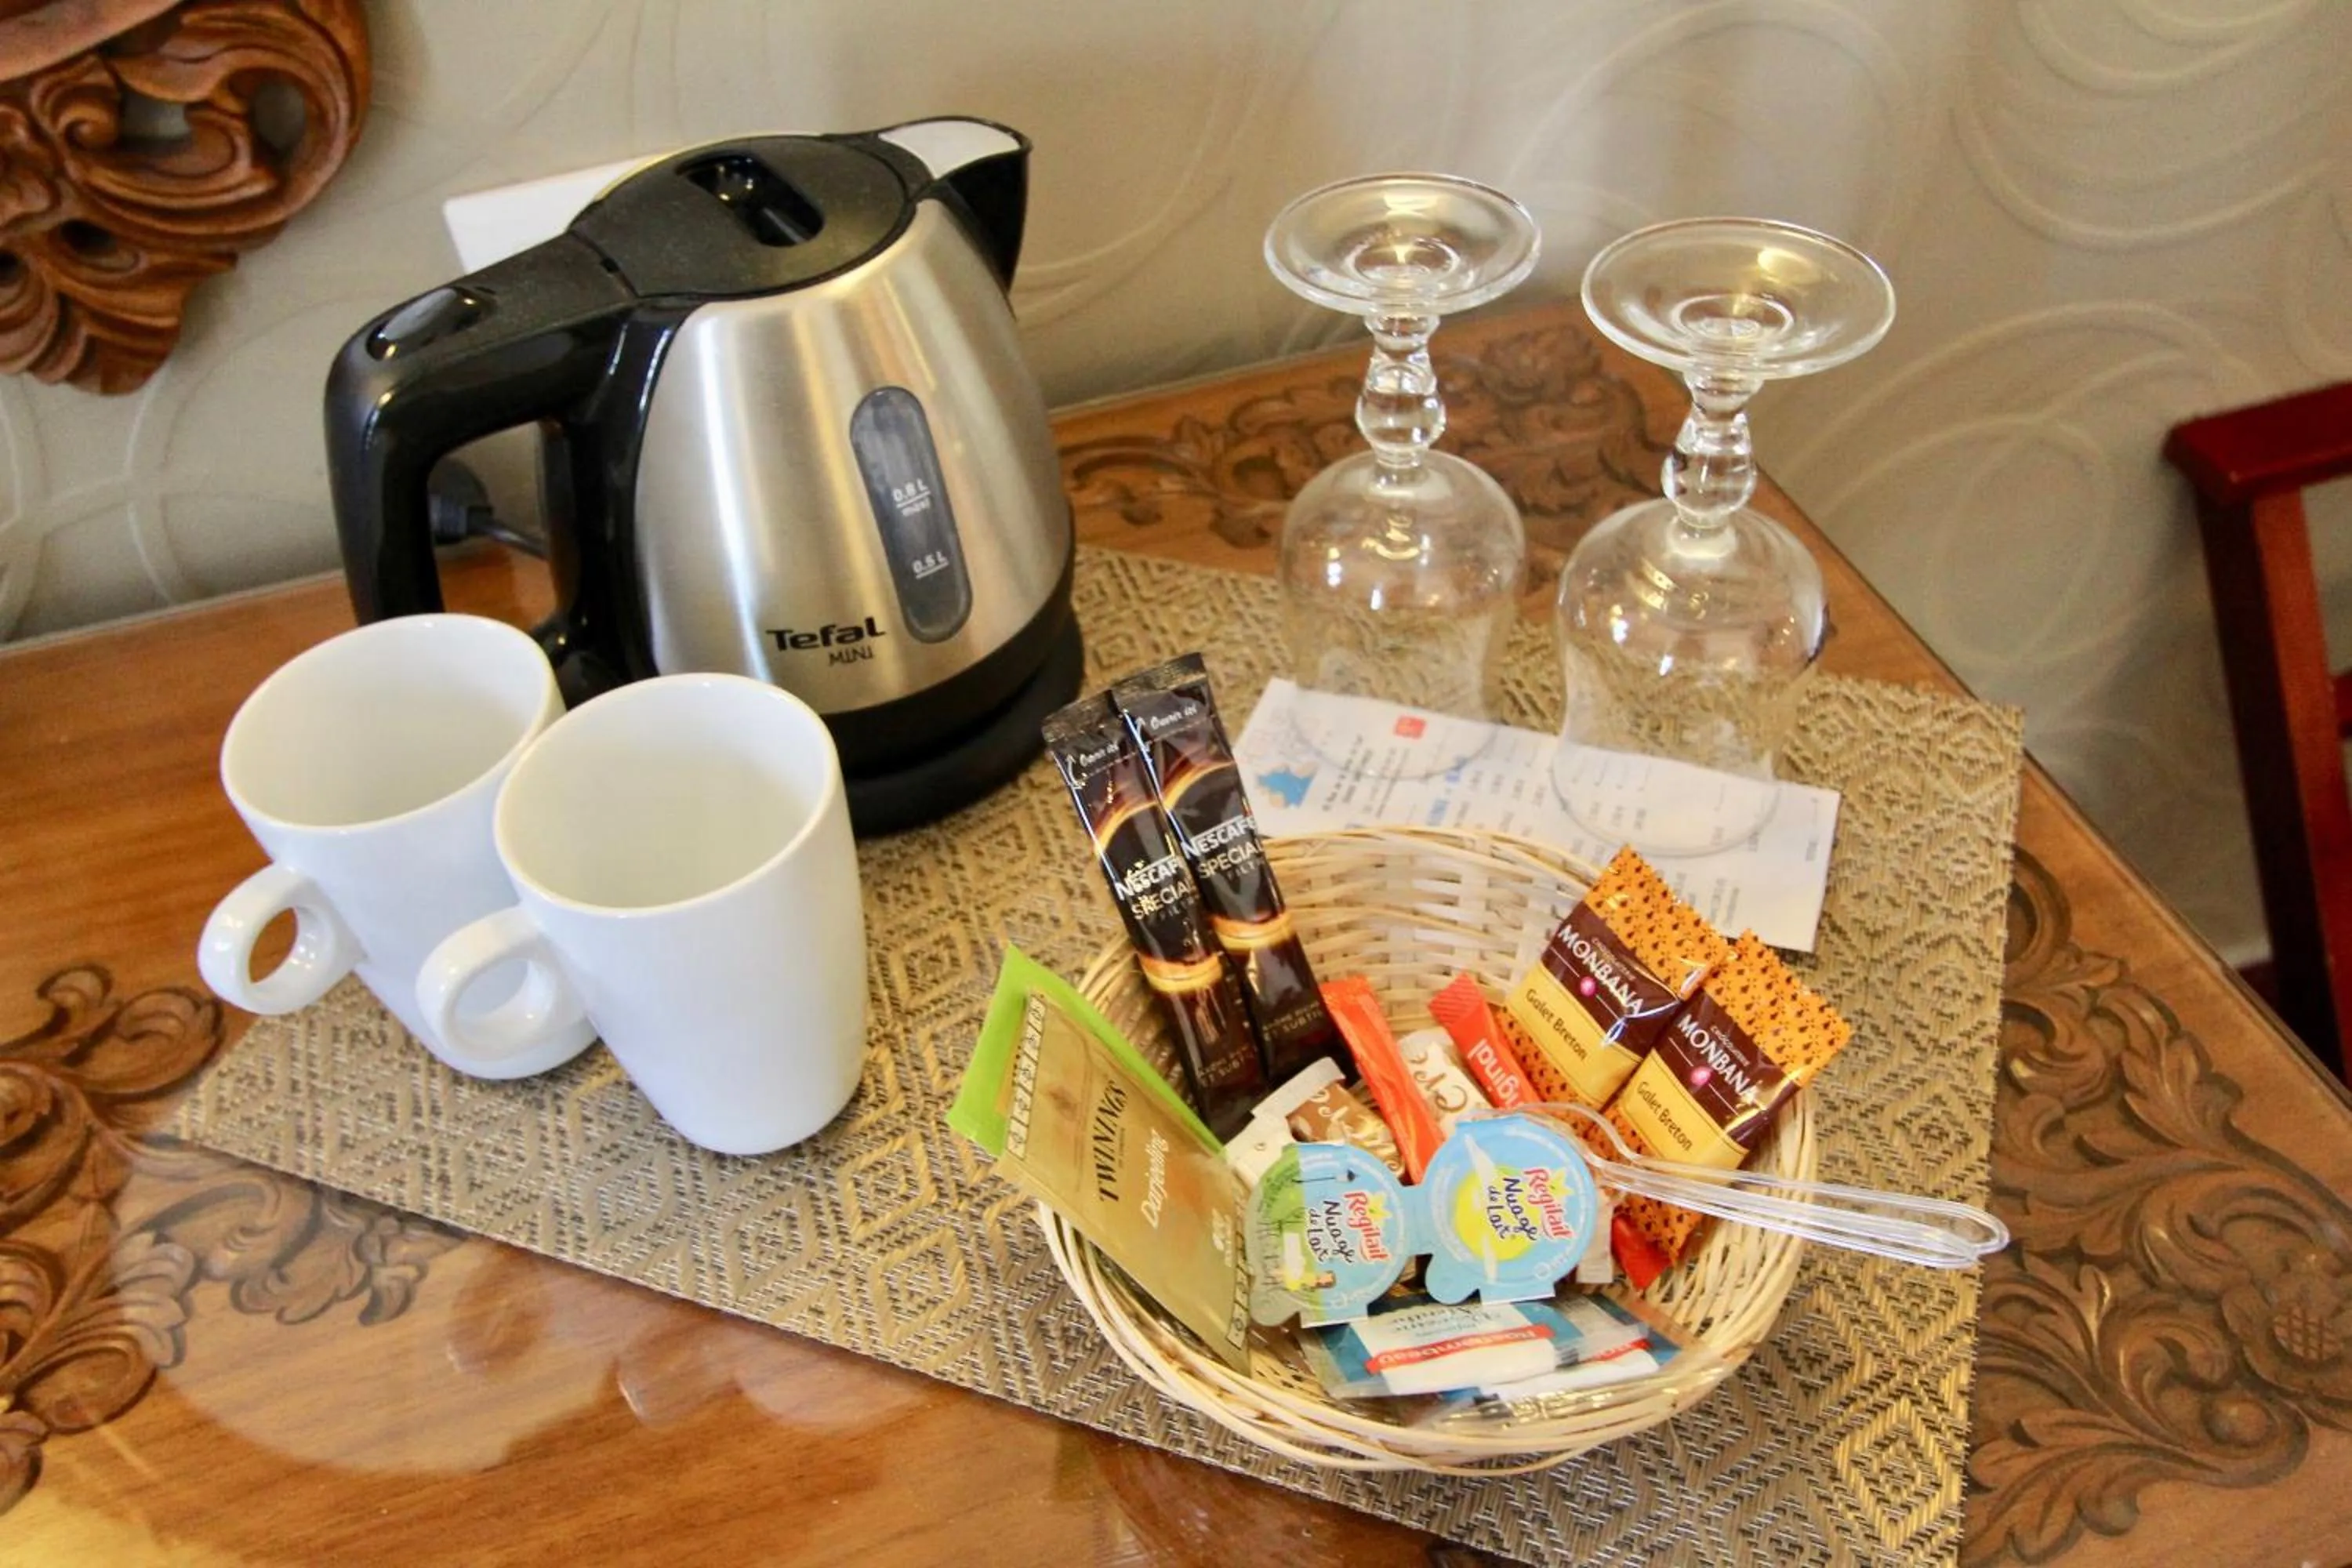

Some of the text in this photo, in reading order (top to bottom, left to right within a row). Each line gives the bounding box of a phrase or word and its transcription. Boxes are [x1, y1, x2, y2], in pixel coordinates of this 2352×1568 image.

[766, 616, 886, 652] Tefal
[829, 647, 874, 666] MINI
[1557, 924, 1645, 1016] MONBANA
[1525, 988, 1588, 1062] Galet Breton
[1676, 1014, 1762, 1104] MONBANA
[1467, 1038, 1526, 1110] riginal
[1093, 1080, 1127, 1202] TWININGS
[1636, 1081, 1694, 1152] Galet Breton
[1323, 1200, 1356, 1264] Nuage
[1503, 1177, 1539, 1241] Nuage
